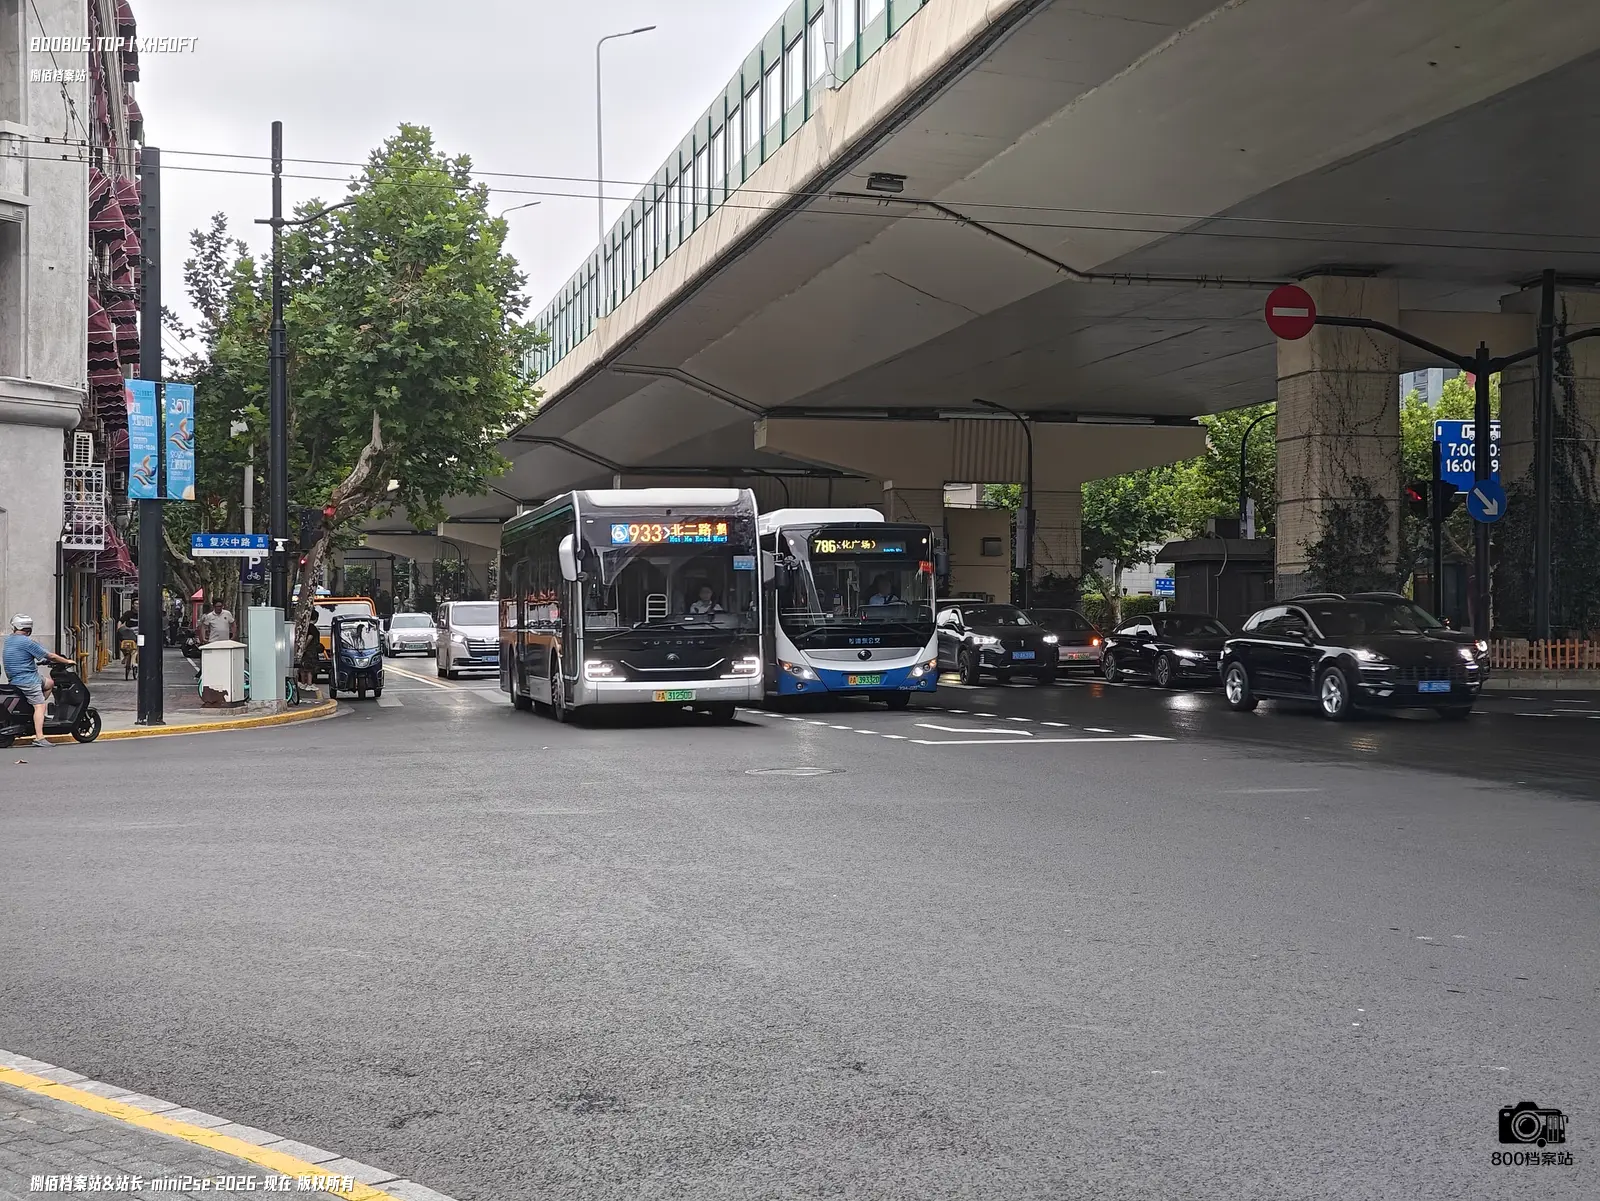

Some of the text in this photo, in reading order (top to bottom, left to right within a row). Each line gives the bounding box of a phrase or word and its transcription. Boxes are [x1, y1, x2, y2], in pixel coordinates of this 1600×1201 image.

[629, 524, 662, 542] 933
[209, 537, 251, 547] 复兴中路
[814, 540, 836, 553] 786
